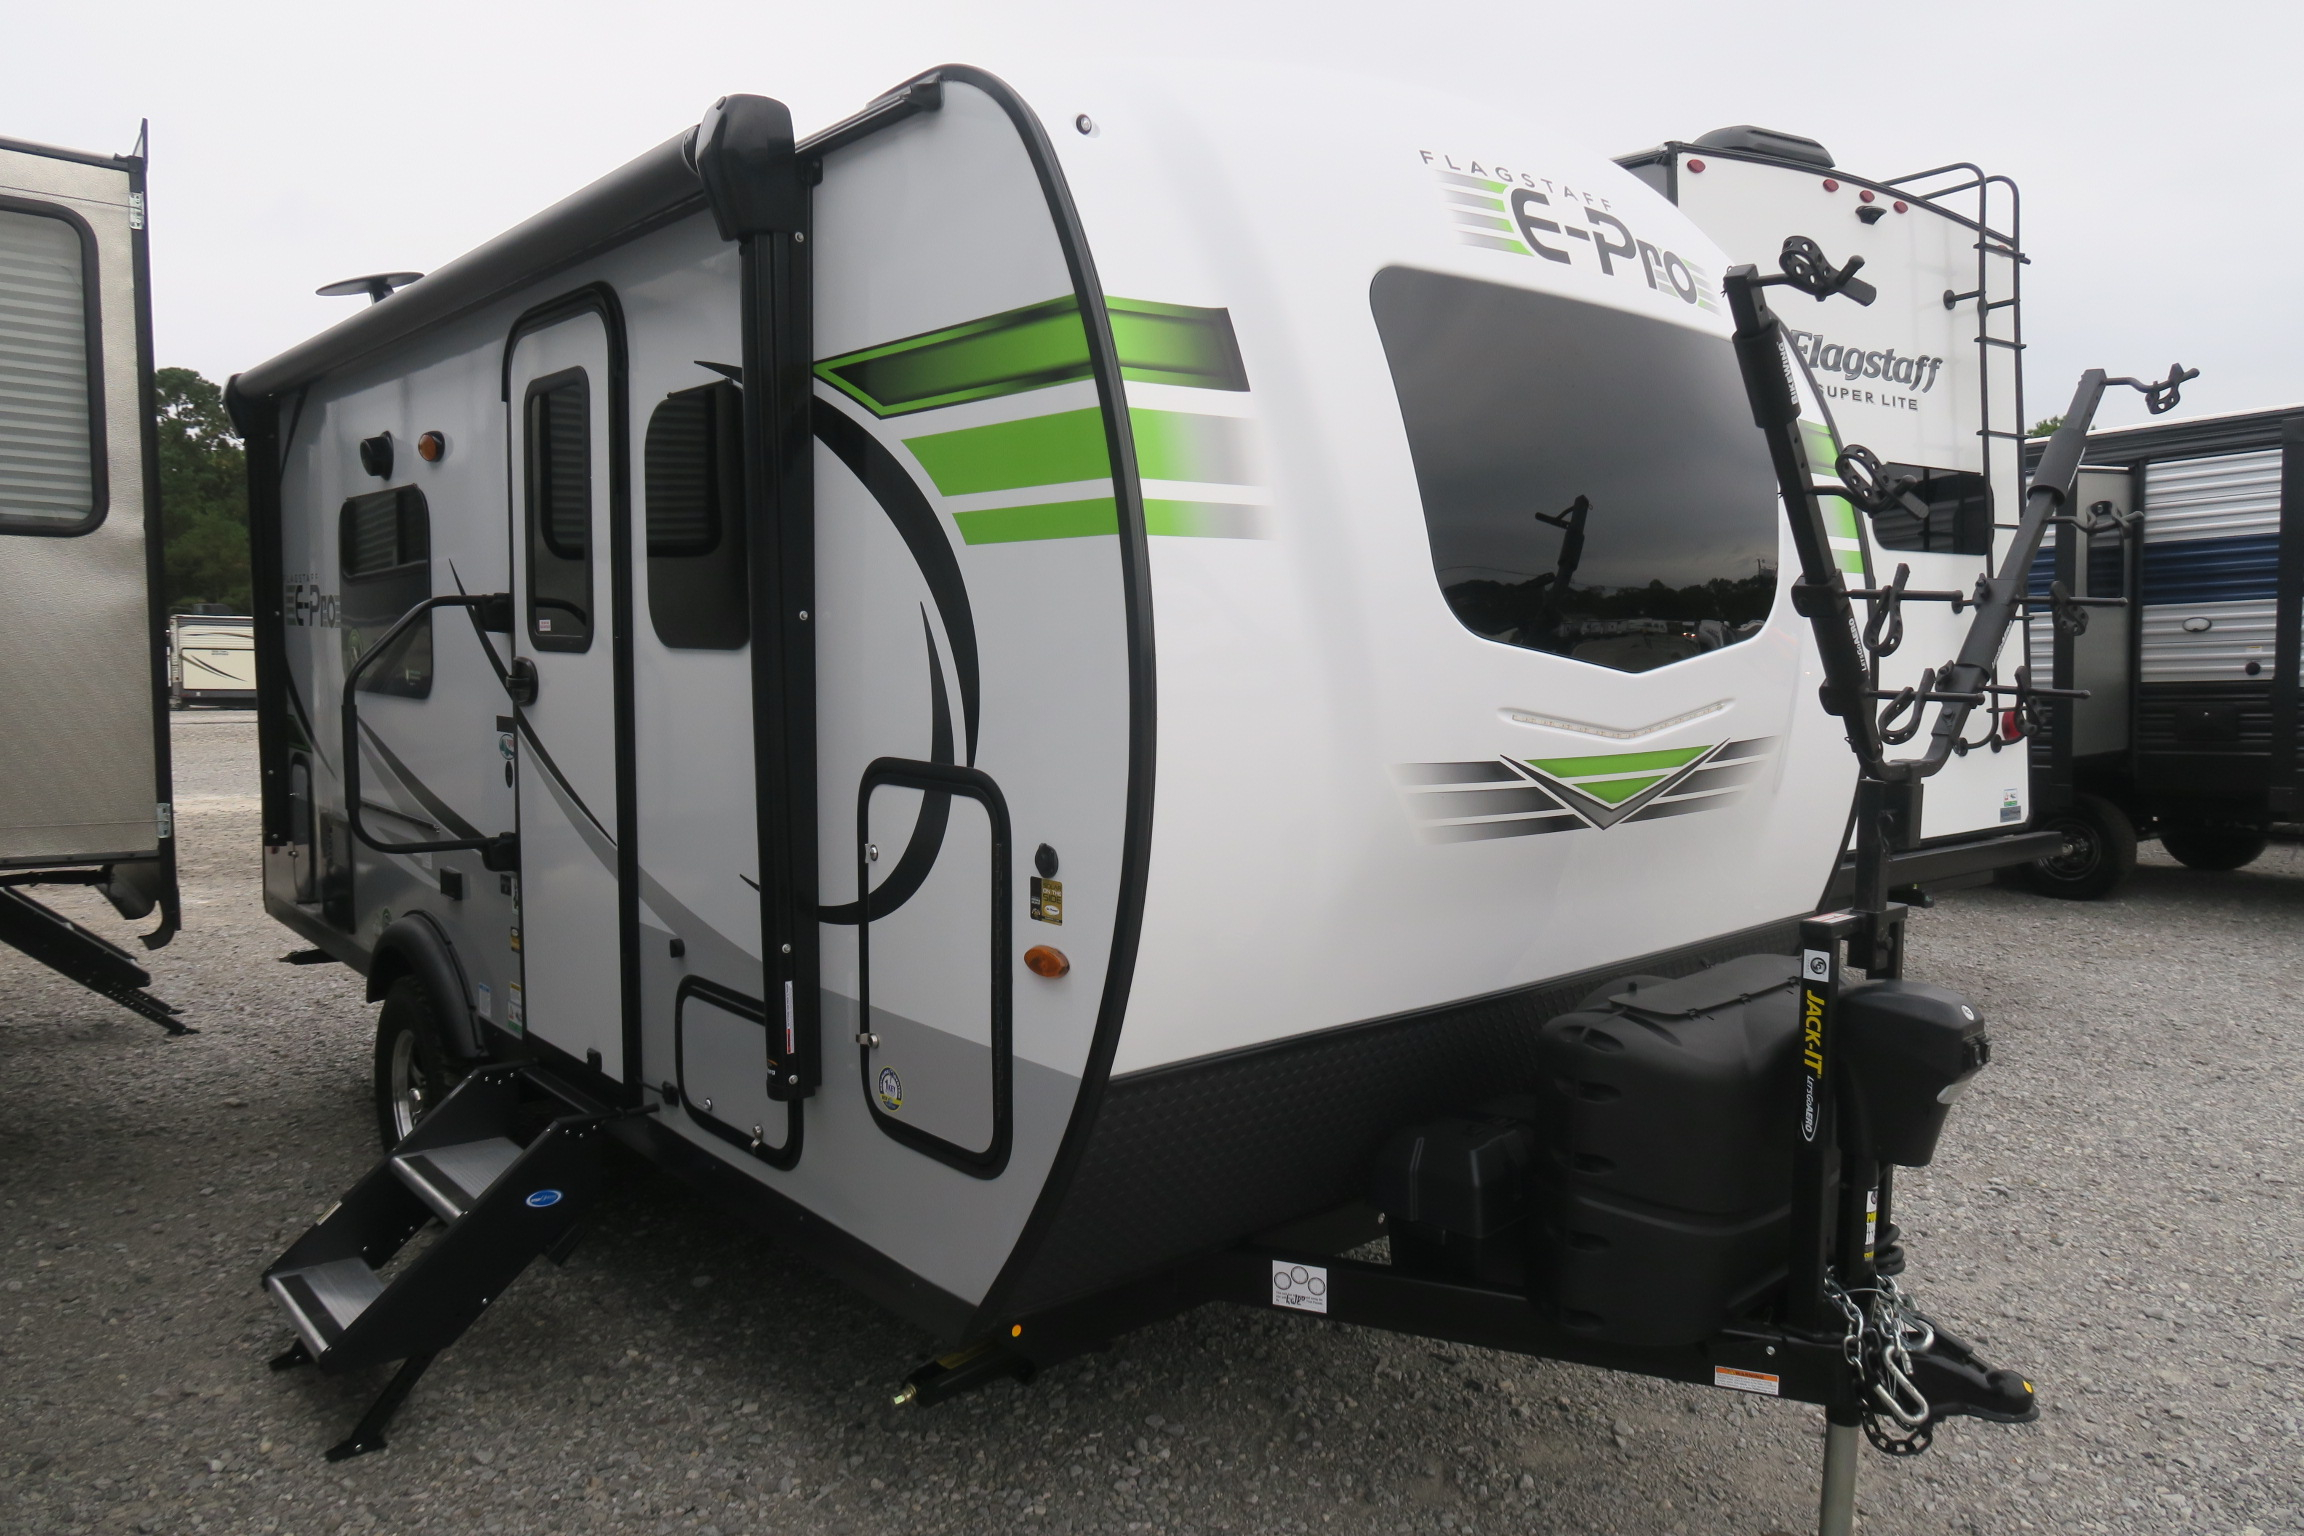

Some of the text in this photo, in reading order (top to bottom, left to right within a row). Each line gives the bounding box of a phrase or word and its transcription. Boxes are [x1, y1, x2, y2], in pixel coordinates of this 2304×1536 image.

[1419, 150, 1612, 212] FLAGSTAFF
[1790, 329, 1943, 393] Flagstaff
[1881, 394, 1919, 411] LITE
[1042, 893, 1062, 905] SIDE
